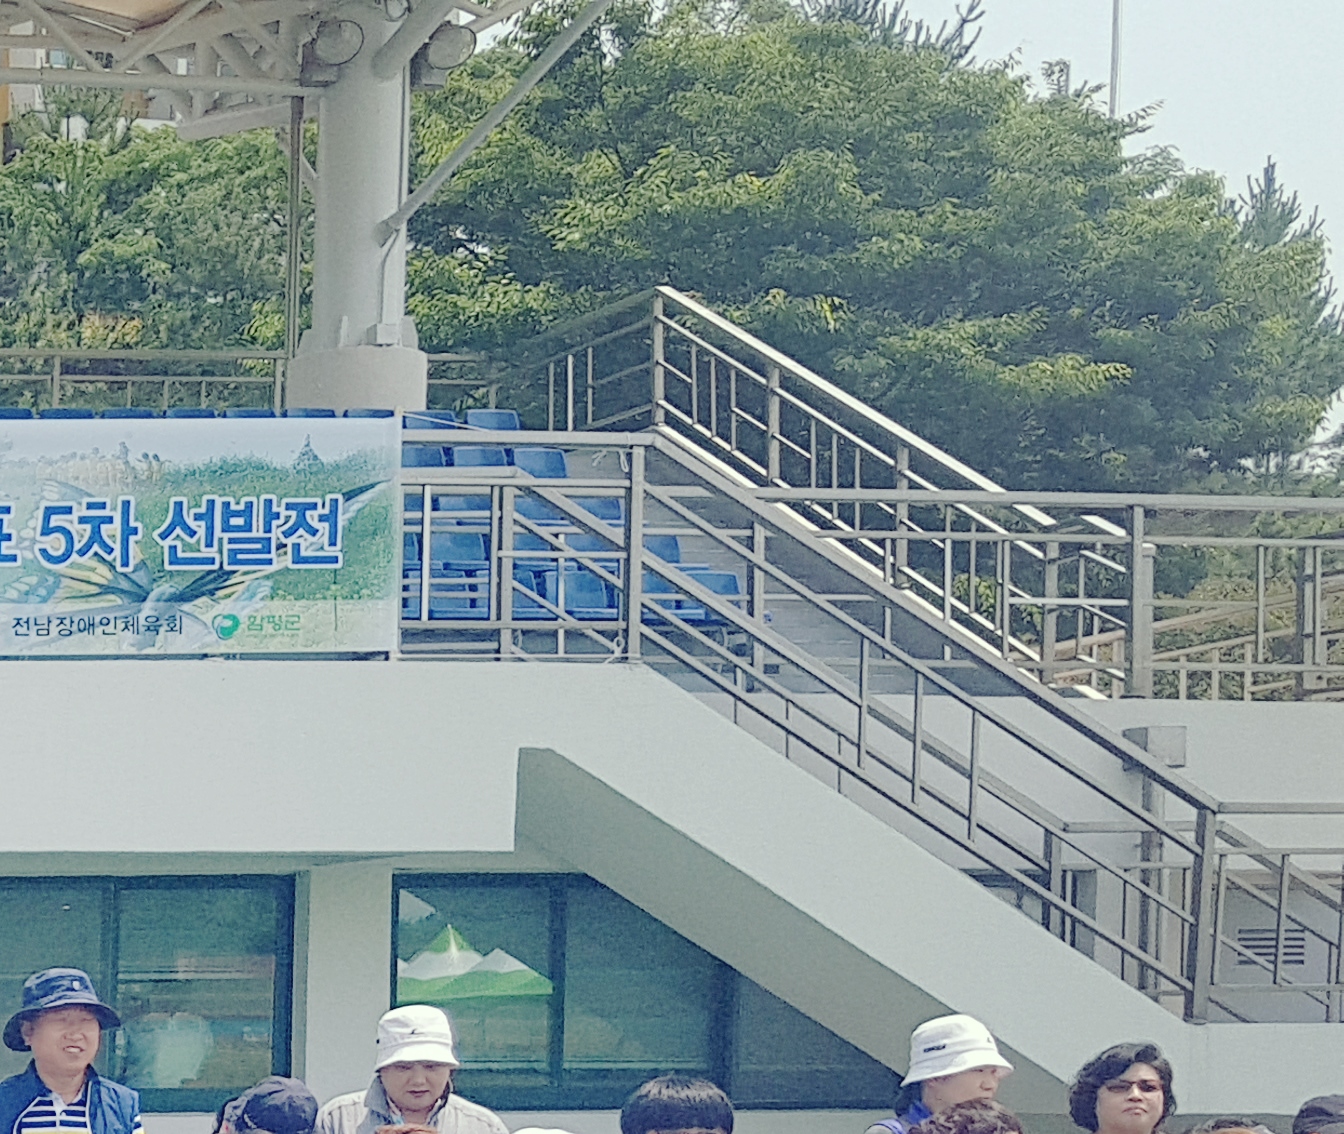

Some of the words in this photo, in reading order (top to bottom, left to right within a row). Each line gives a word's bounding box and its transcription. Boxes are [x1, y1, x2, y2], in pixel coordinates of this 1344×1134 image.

[38, 499, 138, 571] 5차
[158, 495, 343, 568] 선발전
[12, 614, 183, 637] 전남장애인체육회
[246, 613, 301, 632] 함평군
